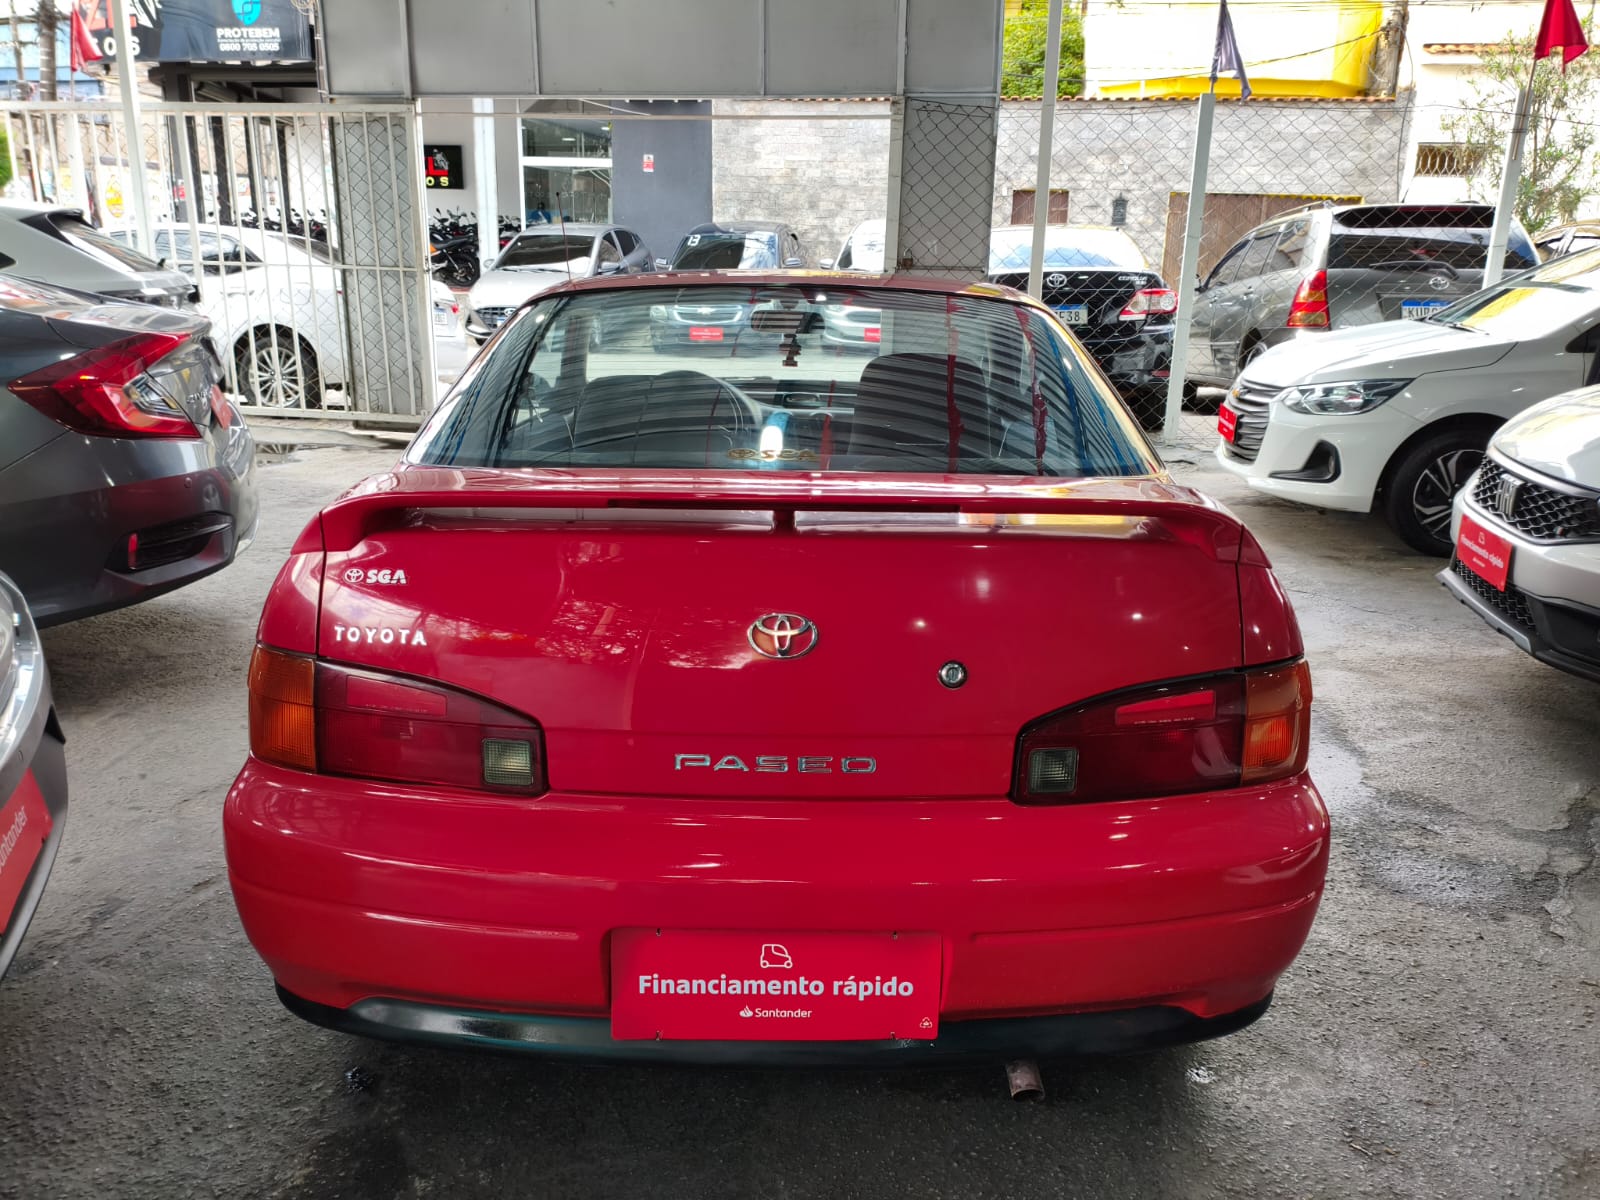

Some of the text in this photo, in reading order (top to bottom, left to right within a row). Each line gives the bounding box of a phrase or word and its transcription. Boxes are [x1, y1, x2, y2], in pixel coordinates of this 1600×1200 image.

[216, 28, 280, 38] PROTEBEM
[365, 569, 407, 584] SGA
[334, 625, 427, 646] TOYOTA
[674, 753, 877, 774] PASEO
[638, 973, 914, 1001] Financiamento rápido
[754, 1006, 812, 1018] Santander
